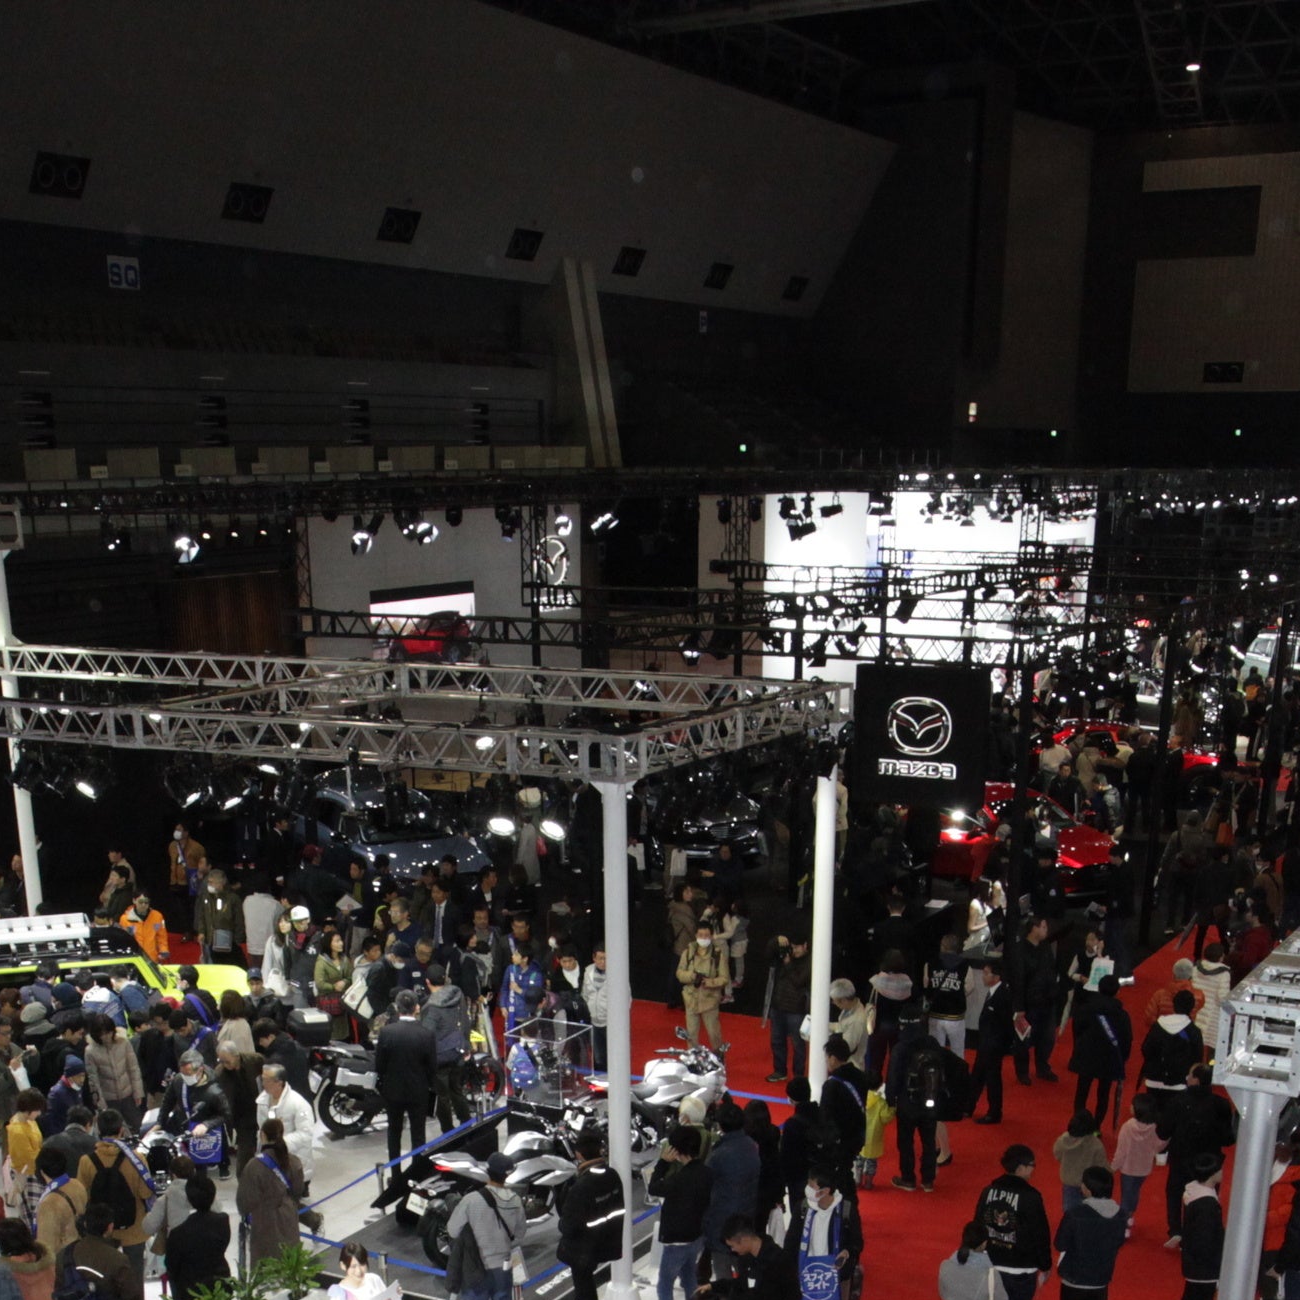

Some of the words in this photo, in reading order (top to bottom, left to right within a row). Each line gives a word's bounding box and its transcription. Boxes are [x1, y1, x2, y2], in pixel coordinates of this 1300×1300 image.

[109, 263, 139, 288] SQ
[986, 1188, 1019, 1211] ALPHA
[804, 1271, 833, 1283] スフィア
[807, 1281, 830, 1291] ライト
